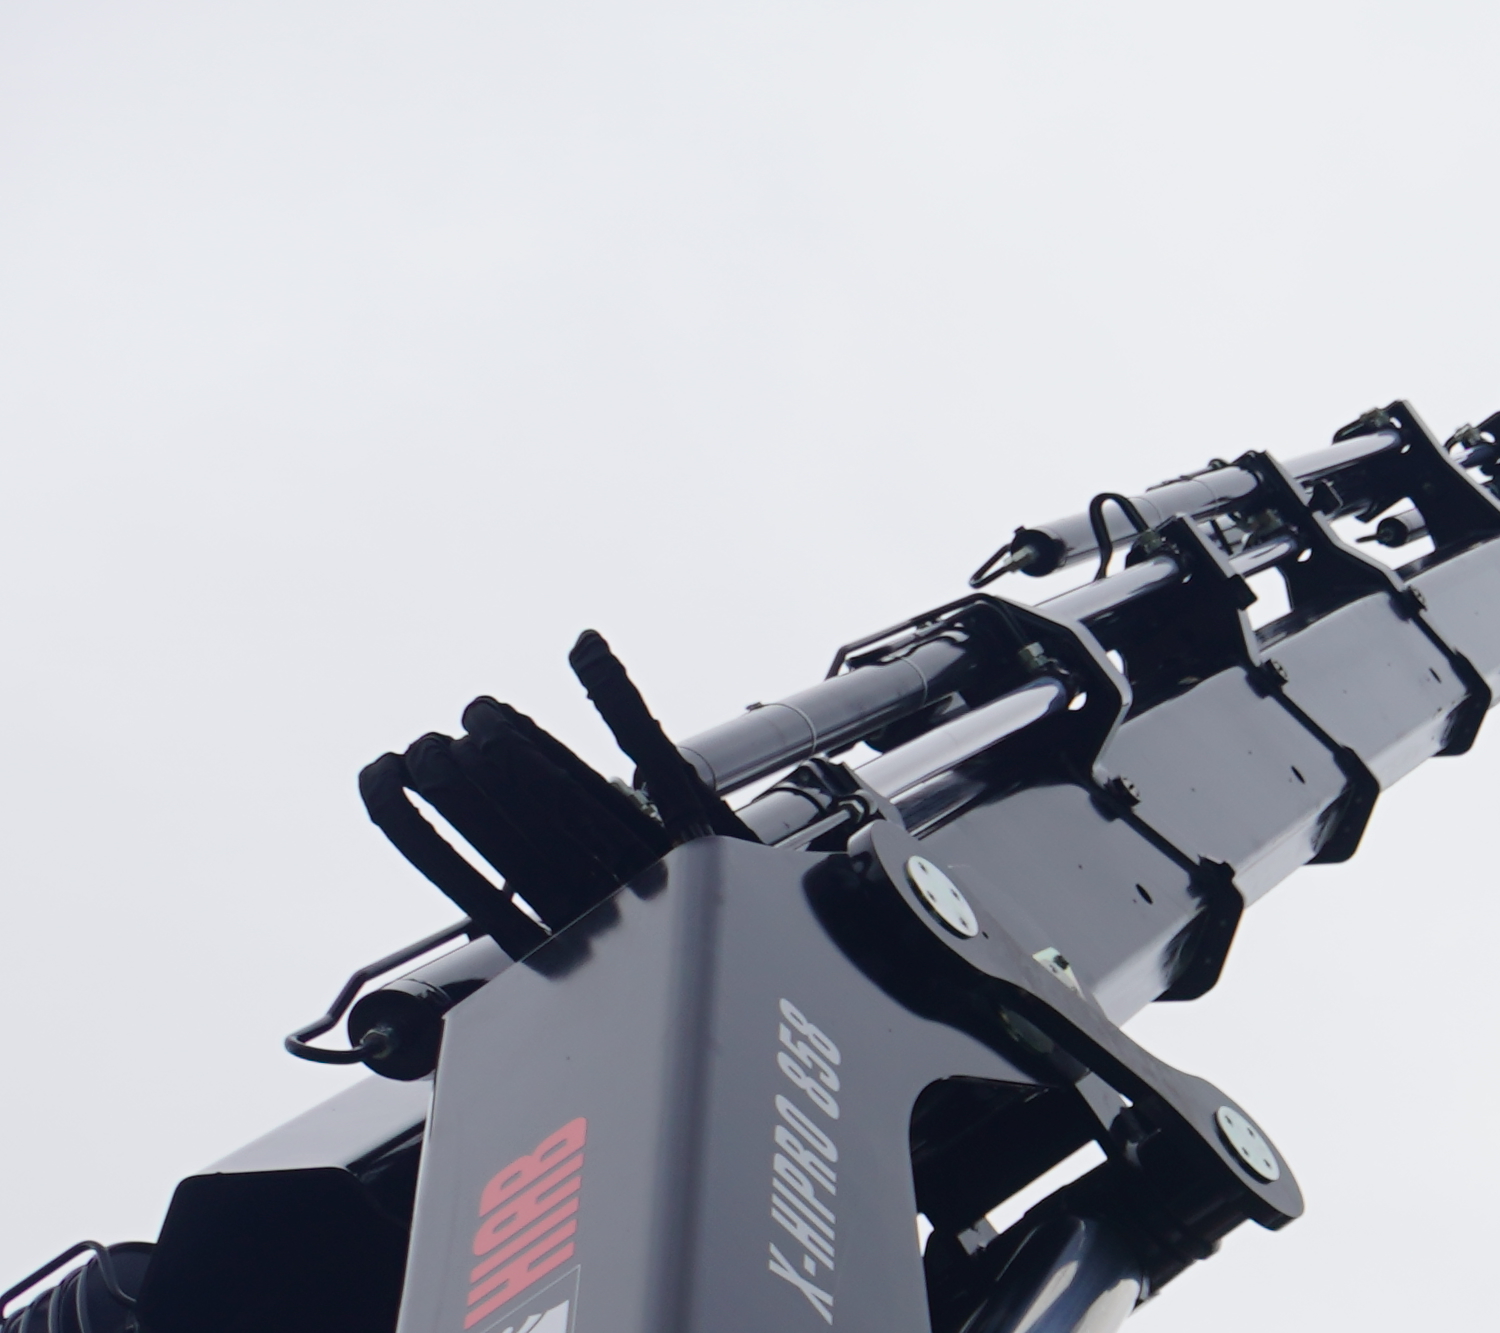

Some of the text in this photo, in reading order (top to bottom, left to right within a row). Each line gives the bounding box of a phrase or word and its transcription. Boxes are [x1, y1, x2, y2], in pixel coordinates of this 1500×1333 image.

[463, 1117, 588, 1330] HIAB
[769, 998, 841, 1325] X-HIPRO 858
